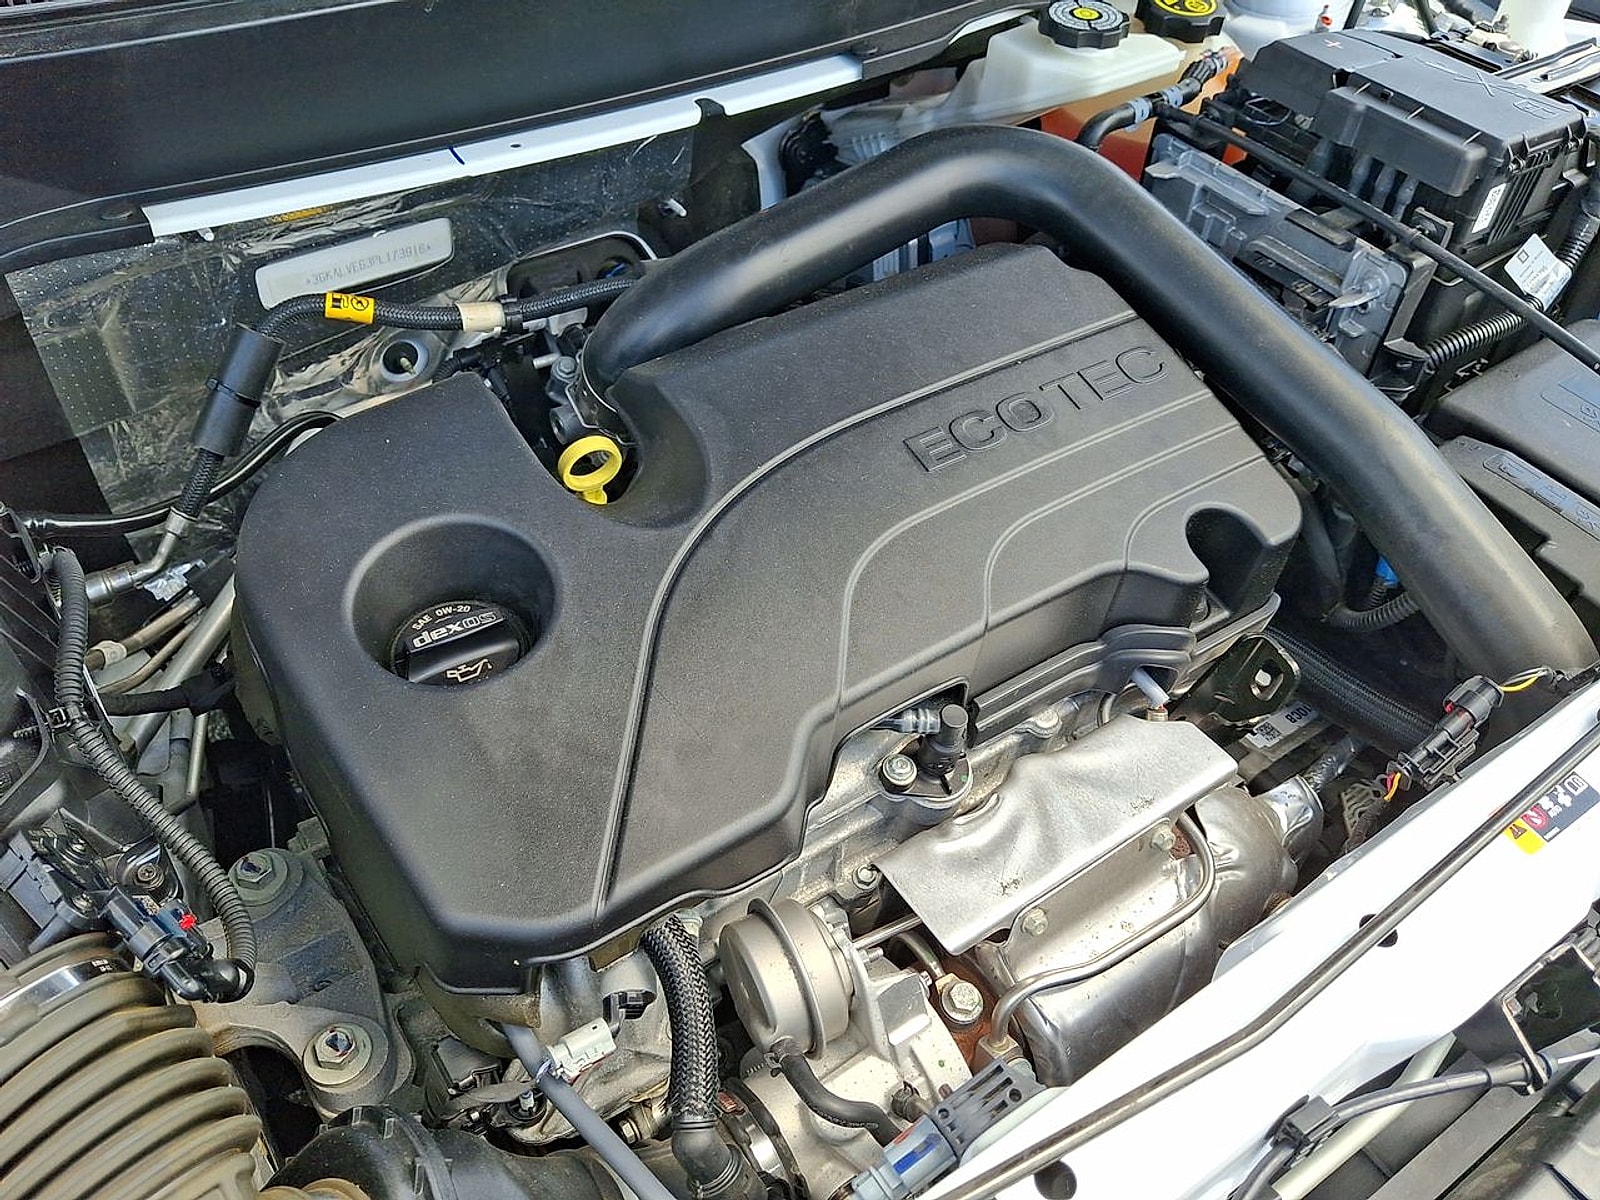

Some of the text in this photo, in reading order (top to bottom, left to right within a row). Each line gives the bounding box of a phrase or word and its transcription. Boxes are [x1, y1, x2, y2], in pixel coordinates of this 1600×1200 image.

[902, 346, 1170, 472] ECOTEC
[412, 605, 471, 630] SAE 0W-20
[413, 612, 497, 648] dexos
